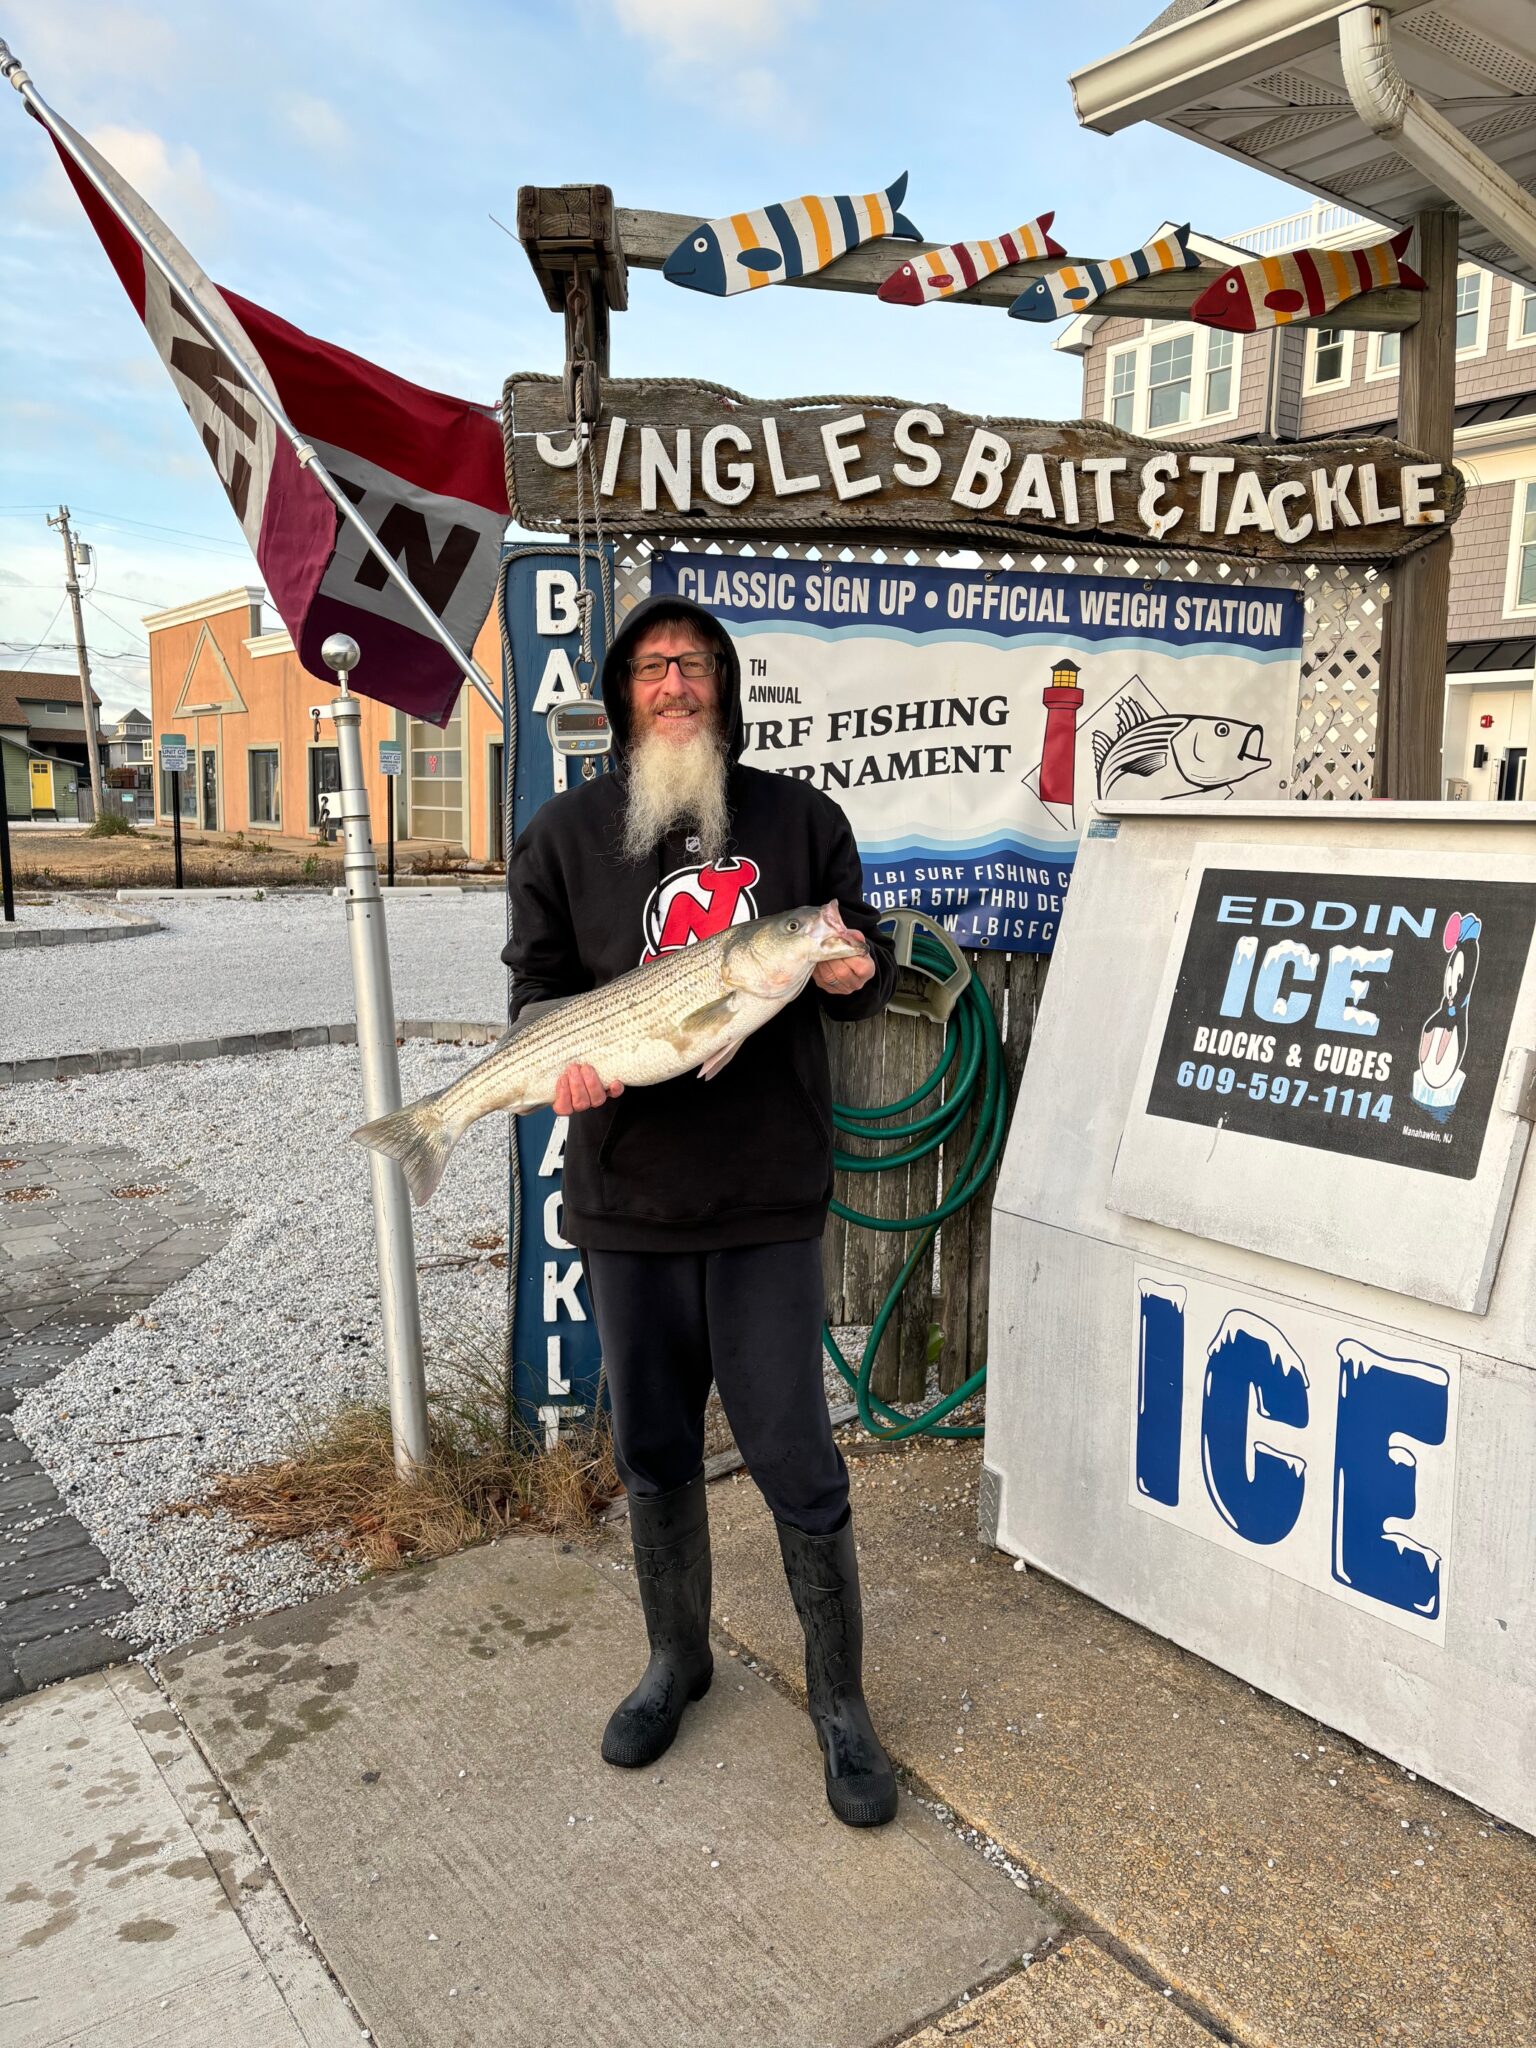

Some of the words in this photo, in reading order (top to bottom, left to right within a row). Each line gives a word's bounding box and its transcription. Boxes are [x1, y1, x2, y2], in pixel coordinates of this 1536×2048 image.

[952, 427, 1127, 525] BAIT
[1138, 452, 1185, 540] &
[1189, 457, 1446, 545] TACKLE
[677, 566, 796, 611] CLASSIC
[804, 575, 870, 614] SIGN
[879, 579, 916, 616] UP
[947, 582, 1070, 625] OFFICIAL
[1080, 590, 1167, 629] WEIGH
[1174, 595, 1283, 637] STATION
[532, 569, 581, 793] BAI
[749, 658, 767, 677] TH
[748, 685, 802, 704] ANNUAL
[827, 695, 1010, 743] FISHING
[762, 744, 1012, 791] RNAMENT
[874, 870, 905, 885] LBI
[915, 867, 965, 882] SURF
[975, 863, 1050, 886] FISHING
[862, 888, 922, 909] OBER
[931, 887, 969, 907] 5TH
[978, 887, 1029, 910] THRU
[1216, 895, 1437, 938] EDDIN
[923, 914, 1053, 941] W.LBISFC
[1219, 935, 1394, 1036] ICE
[1193, 1026, 1277, 1063] BLOCKS
[1286, 1043, 1302, 1068] &
[1314, 1043, 1393, 1081] CUBES
[1176, 1061, 1394, 1123] 609-597-1114
[1402, 1125, 1441, 1143] Manahawkin,
[1443, 1132, 1453, 1144] NJ
[1136, 1277, 1450, 1621] ICE
